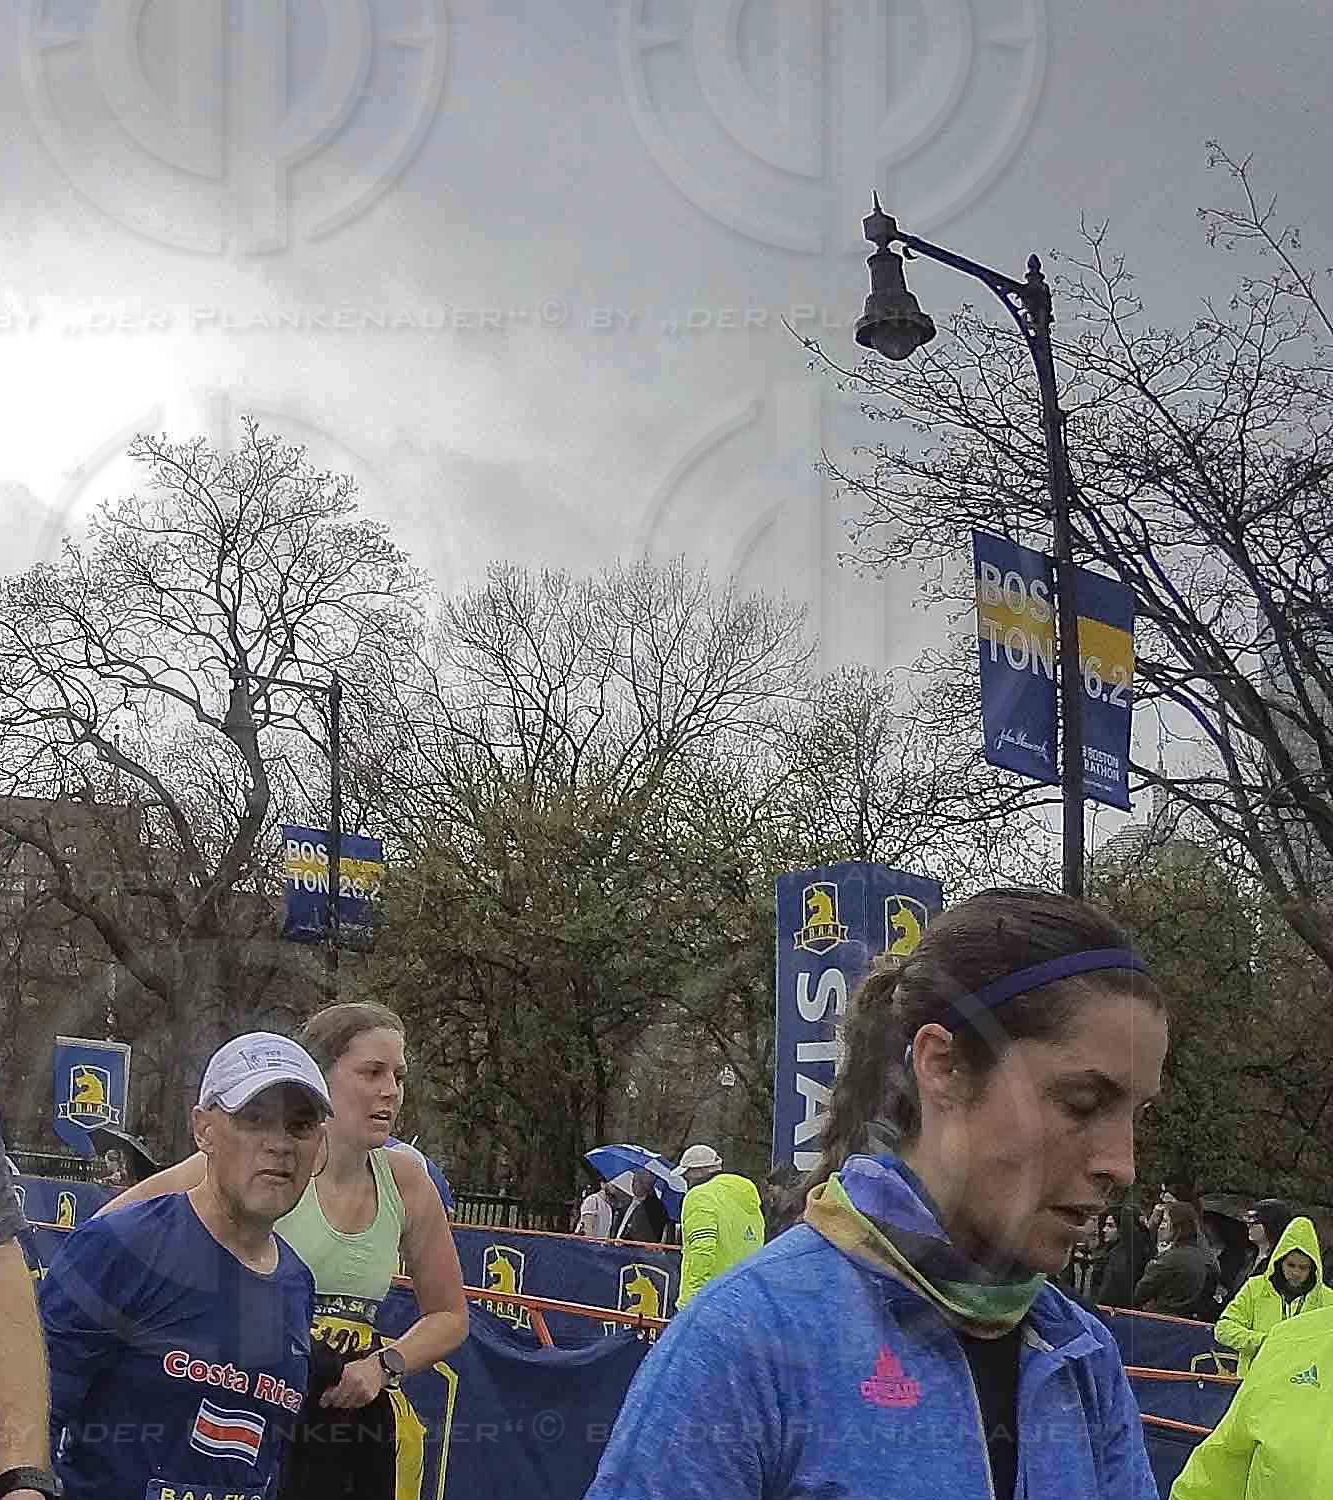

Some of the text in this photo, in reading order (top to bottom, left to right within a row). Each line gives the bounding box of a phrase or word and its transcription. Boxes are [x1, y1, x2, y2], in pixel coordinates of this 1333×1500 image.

[980, 561, 1052, 624] BOS
[980, 616, 1054, 681] TON
[286, 839, 329, 866] BOS
[293, 867, 331, 895] TON
[163, 1350, 303, 1415] Costa Rica
